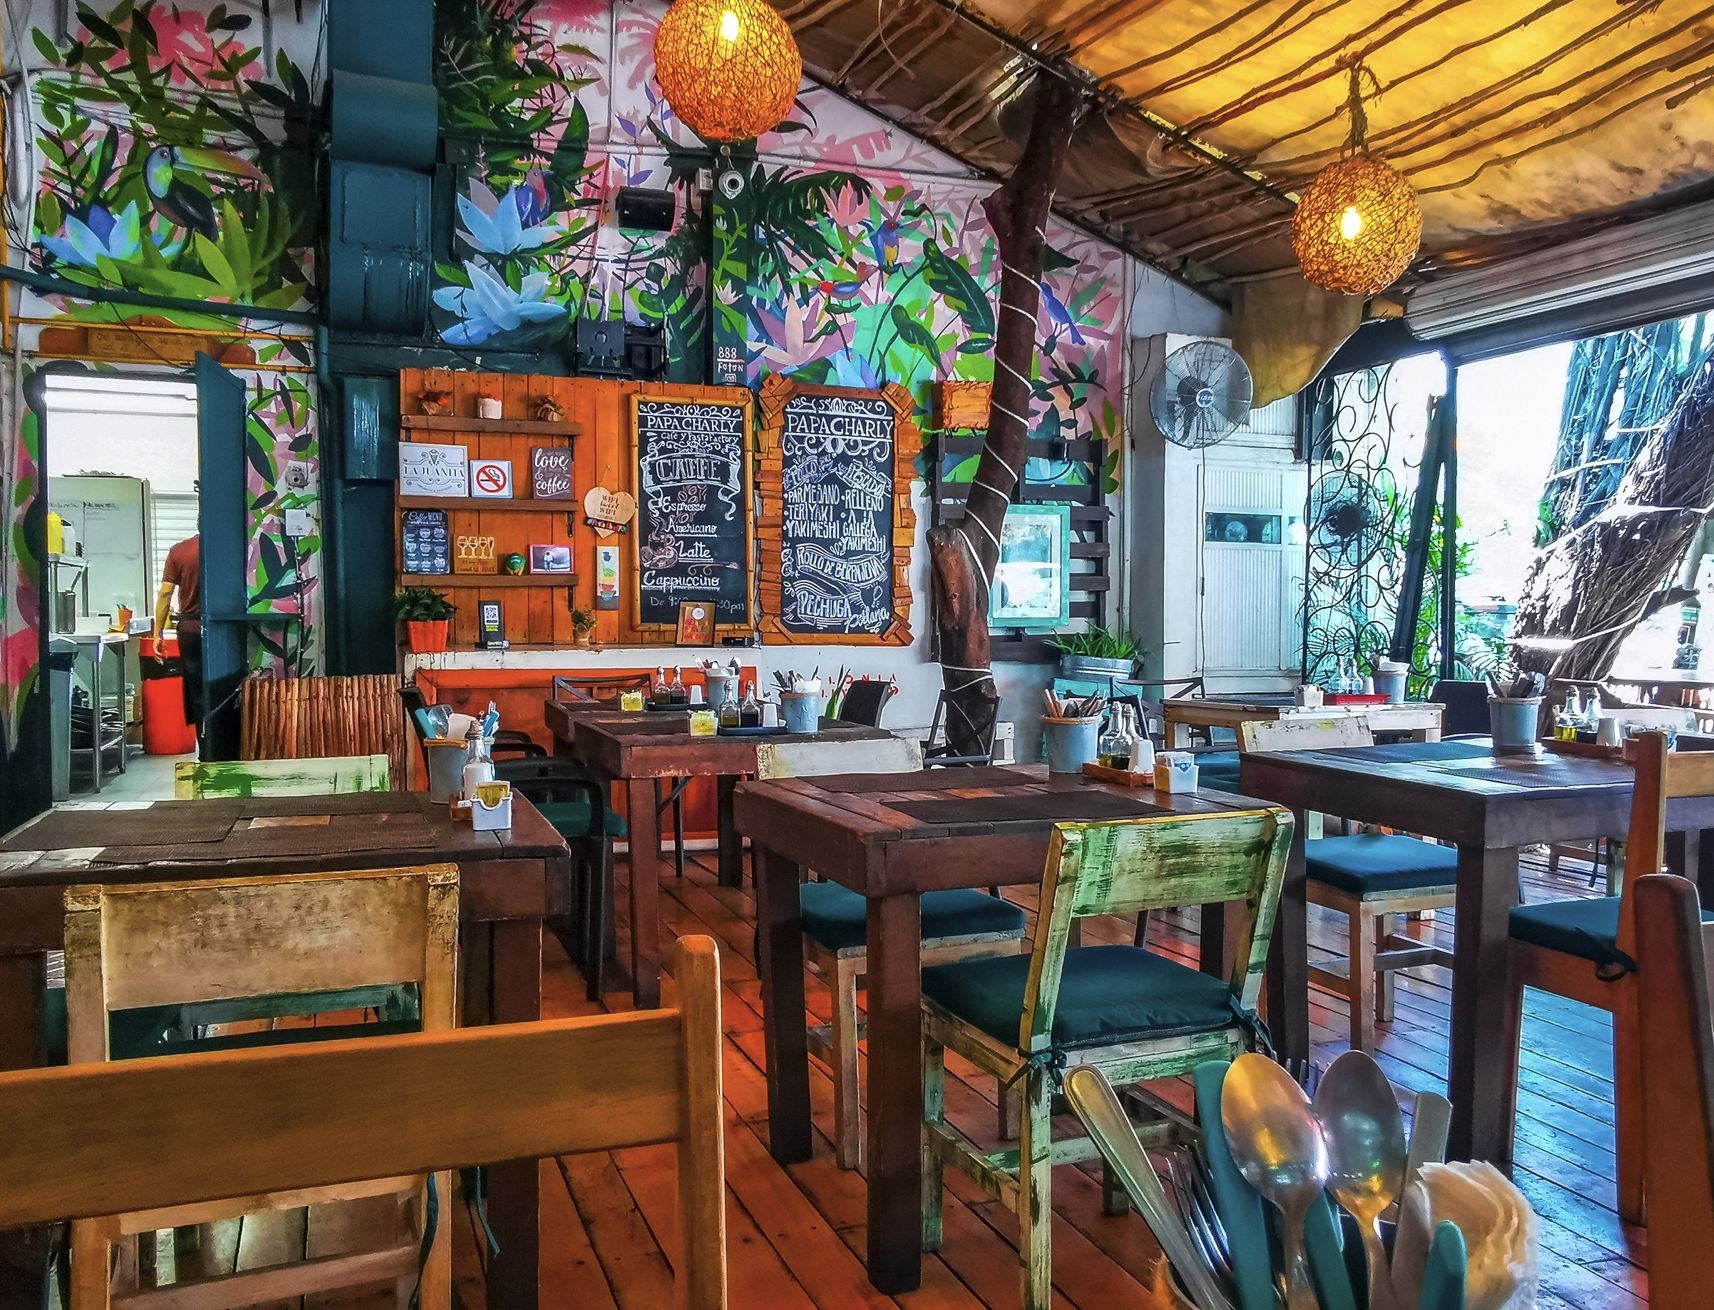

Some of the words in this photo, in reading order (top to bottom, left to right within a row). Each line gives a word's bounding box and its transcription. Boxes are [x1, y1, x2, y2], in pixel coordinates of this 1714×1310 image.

[718, 346, 737, 359] 888
[647, 415, 681, 430] PAPA
[682, 418, 737, 433] CHARLY
[787, 414, 830, 434] PAPA
[830, 417, 893, 439] CHARLY
[534, 448, 569, 470] love
[535, 476, 570, 495] coffee
[788, 484, 840, 505] PARMESANO
[661, 496, 707, 515] Espresso
[845, 489, 884, 512] RELLENO
[787, 502, 833, 521] TERIYAKI
[665, 517, 718, 534] Americano
[785, 519, 840, 538] YAKIMESHI
[675, 540, 711, 558] Latte
[842, 535, 886, 553] YAKIMESHI
[797, 546, 824, 570] ROLLO
[642, 570, 721, 593] Cappuccino
[800, 590, 852, 618] PECHUGA
[844, 606, 890, 634] poblana
